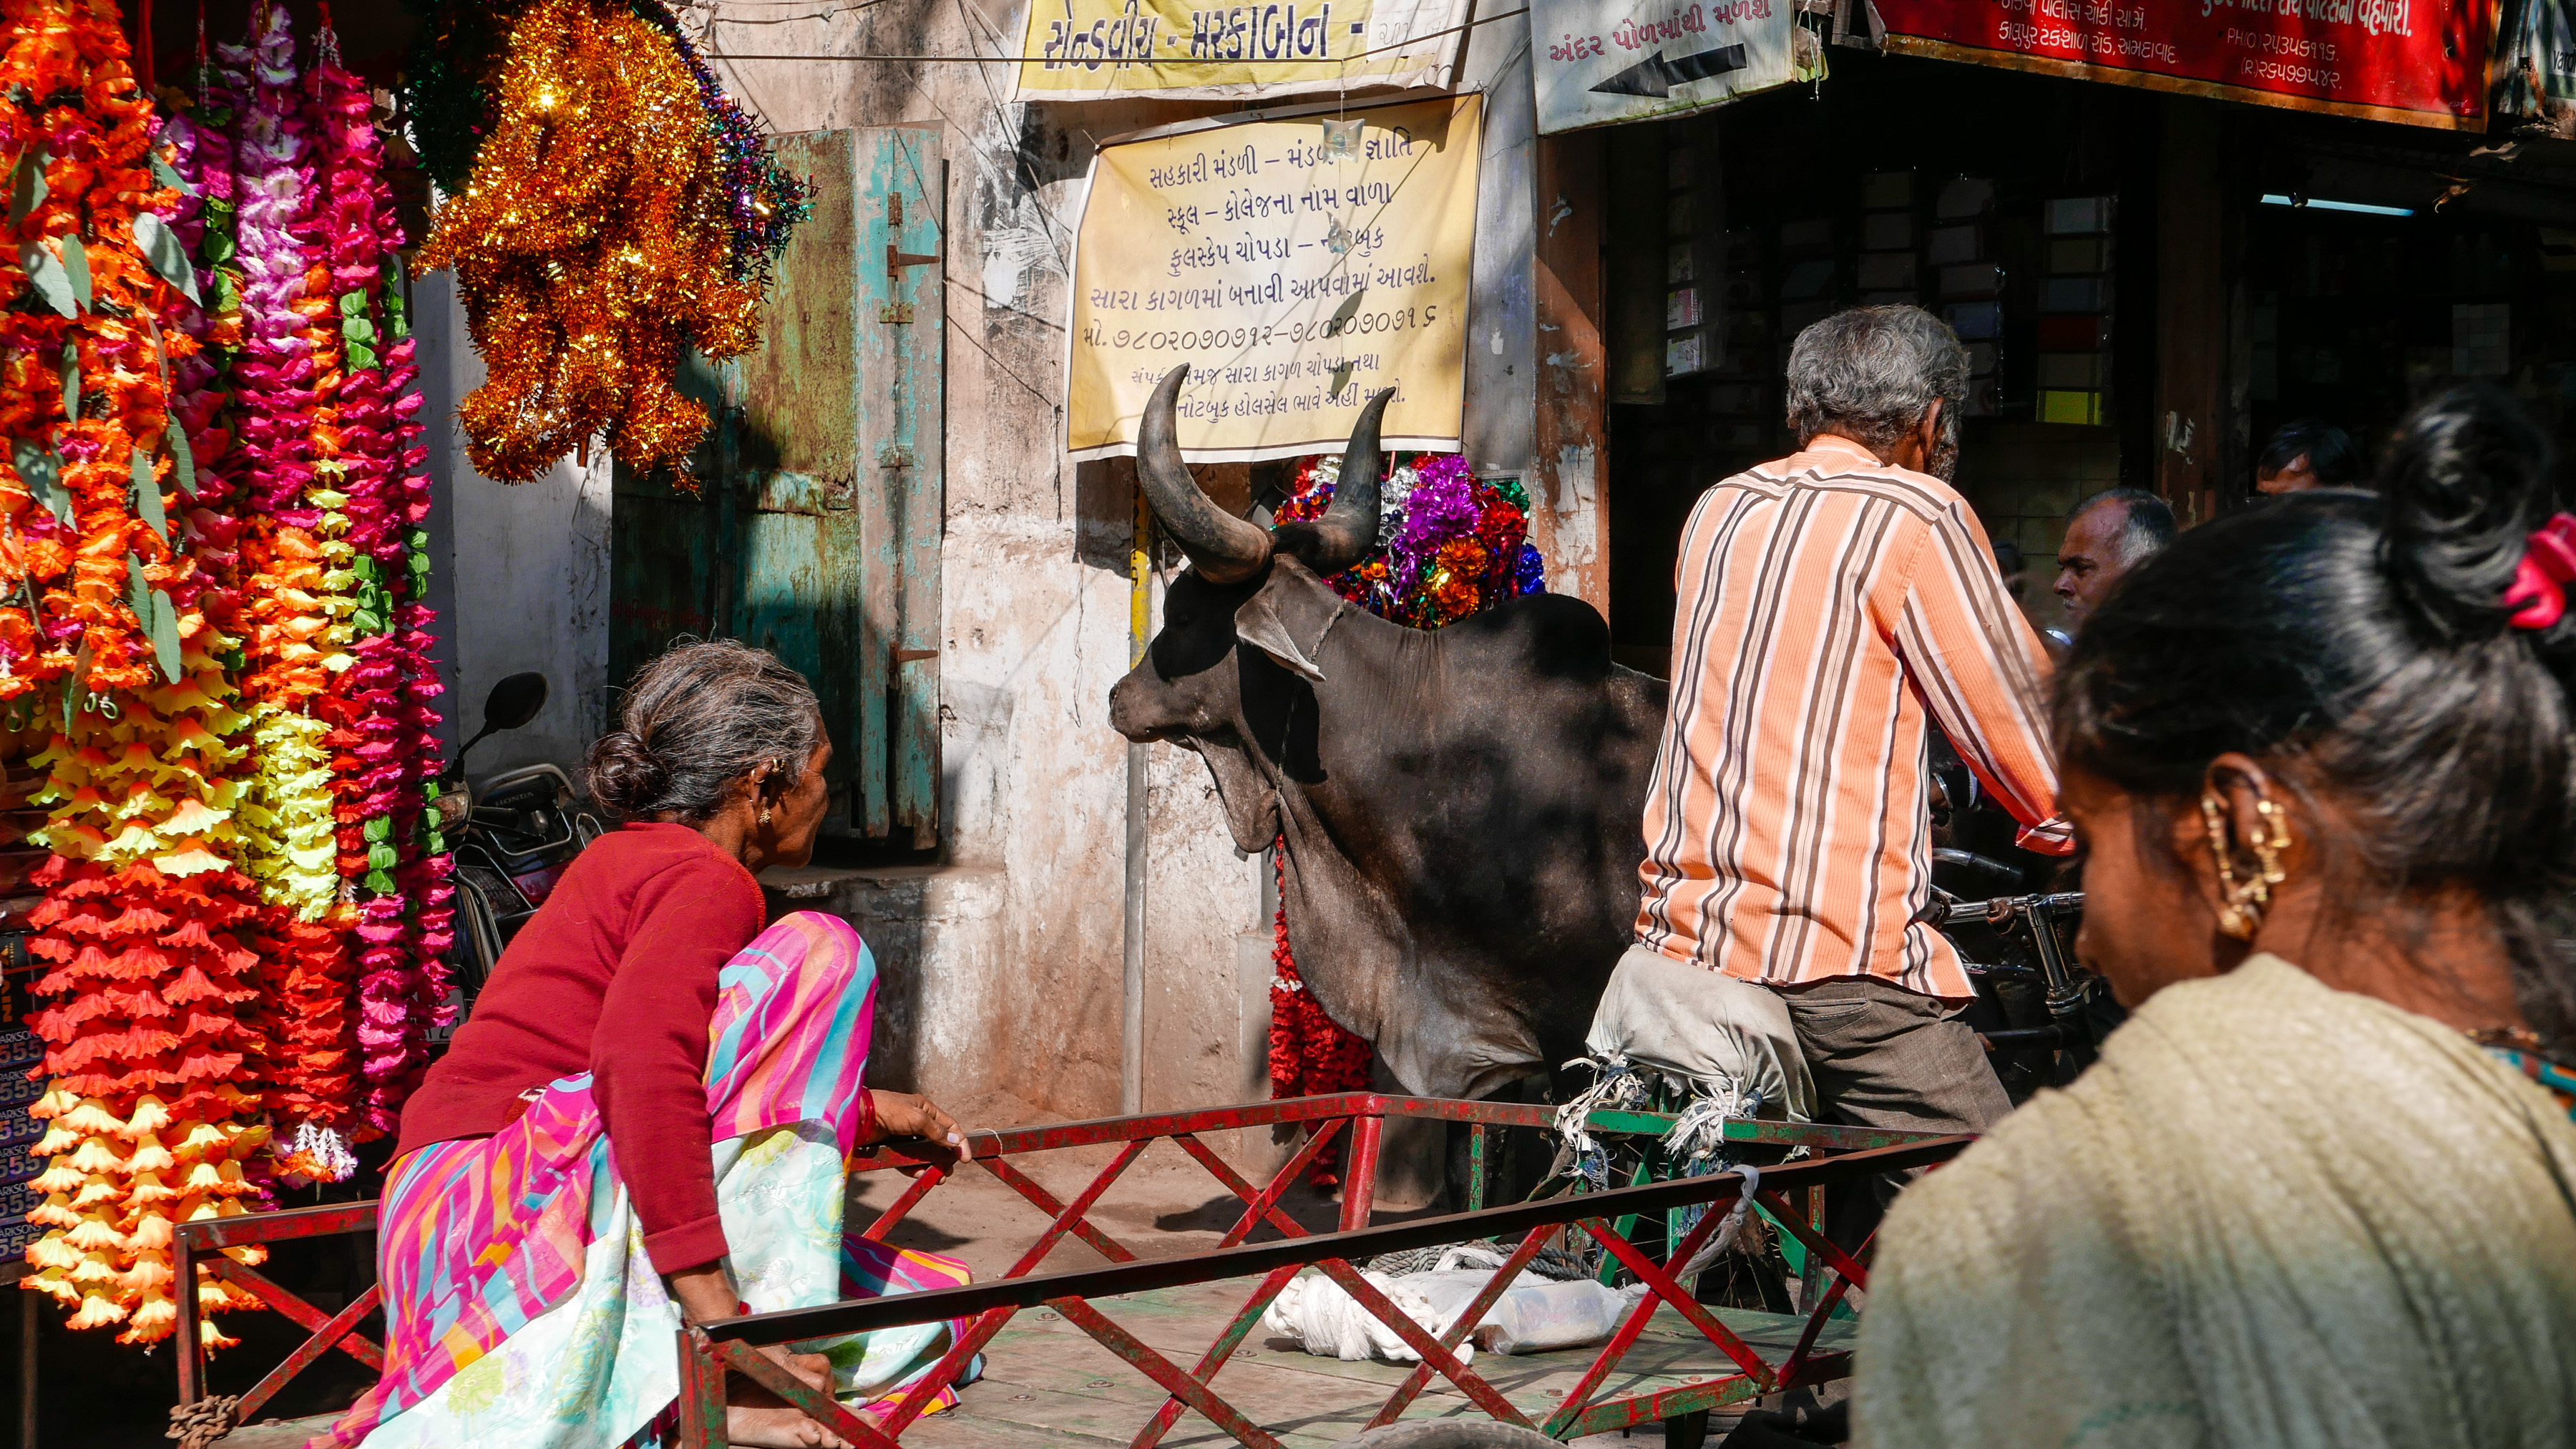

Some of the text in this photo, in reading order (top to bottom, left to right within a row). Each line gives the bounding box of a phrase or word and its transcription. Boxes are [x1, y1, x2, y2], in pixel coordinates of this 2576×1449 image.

[1549, 34, 1605, 62] અંદર
[1613, 4, 1706, 51] પોળમાંથી
[1999, 21, 2037, 49] કાલુપુર
[2092, 31, 2116, 56] રોડ,
[2118, 38, 2179, 64] અમદાવાદ.
[1149, 152, 1208, 188] સહકારી
[1213, 145, 1258, 179] મંડળી
[1365, 125, 1413, 161] જ્ઞાતિ
[1167, 205, 1200, 235] સ્કૂલ
[1224, 188, 1294, 221] કોલેજના
[1345, 182, 1392, 207] વાળા
[1167, 236, 1230, 277] ફુલસ્કેપ
[1236, 231, 1291, 262] ચોપડા
[1091, 253, 1436, 311] સારા કાગળમાં બનાવી આપવામાં આવશે.
[1083, 318, 1108, 347] મો.
[1225, 366, 1257, 384] સારા
[1262, 361, 1301, 381] કાગળ
[1306, 352, 1345, 376] ચોપડા
[1351, 353, 1380, 371] તથા
[1177, 394, 1229, 424] નોટબુક
[1234, 391, 1288, 416] હોલસેલ
[1293, 386, 1321, 411] ભાવે
